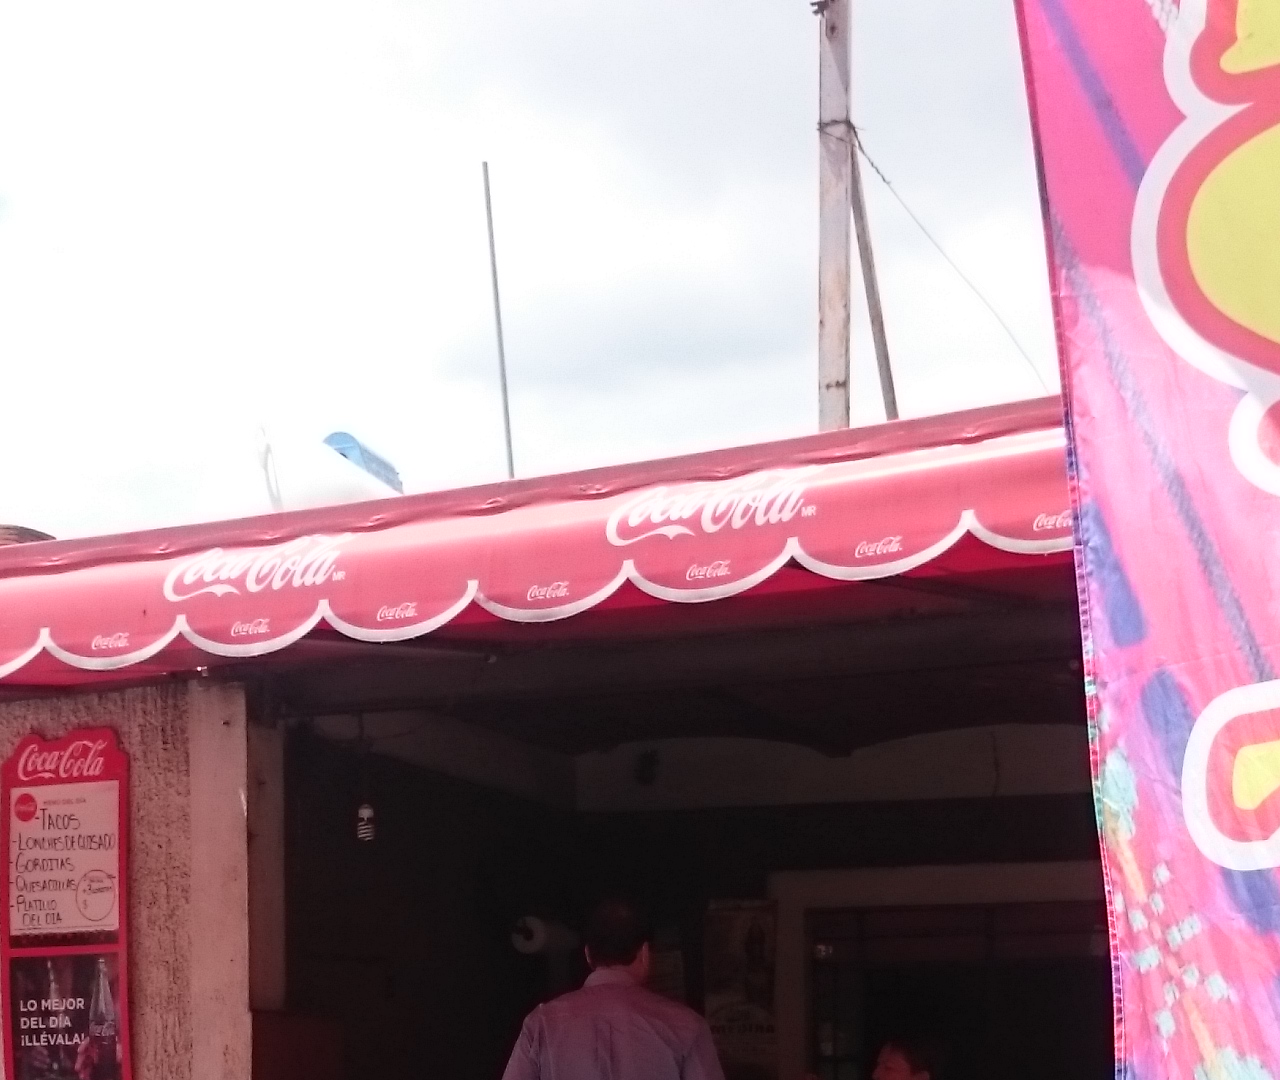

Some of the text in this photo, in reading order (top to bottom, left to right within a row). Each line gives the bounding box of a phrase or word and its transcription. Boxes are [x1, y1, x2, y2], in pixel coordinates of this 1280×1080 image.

[20, 998, 85, 1012] LO MEJOR
[21, 1013, 71, 1030] DEL DÍA
